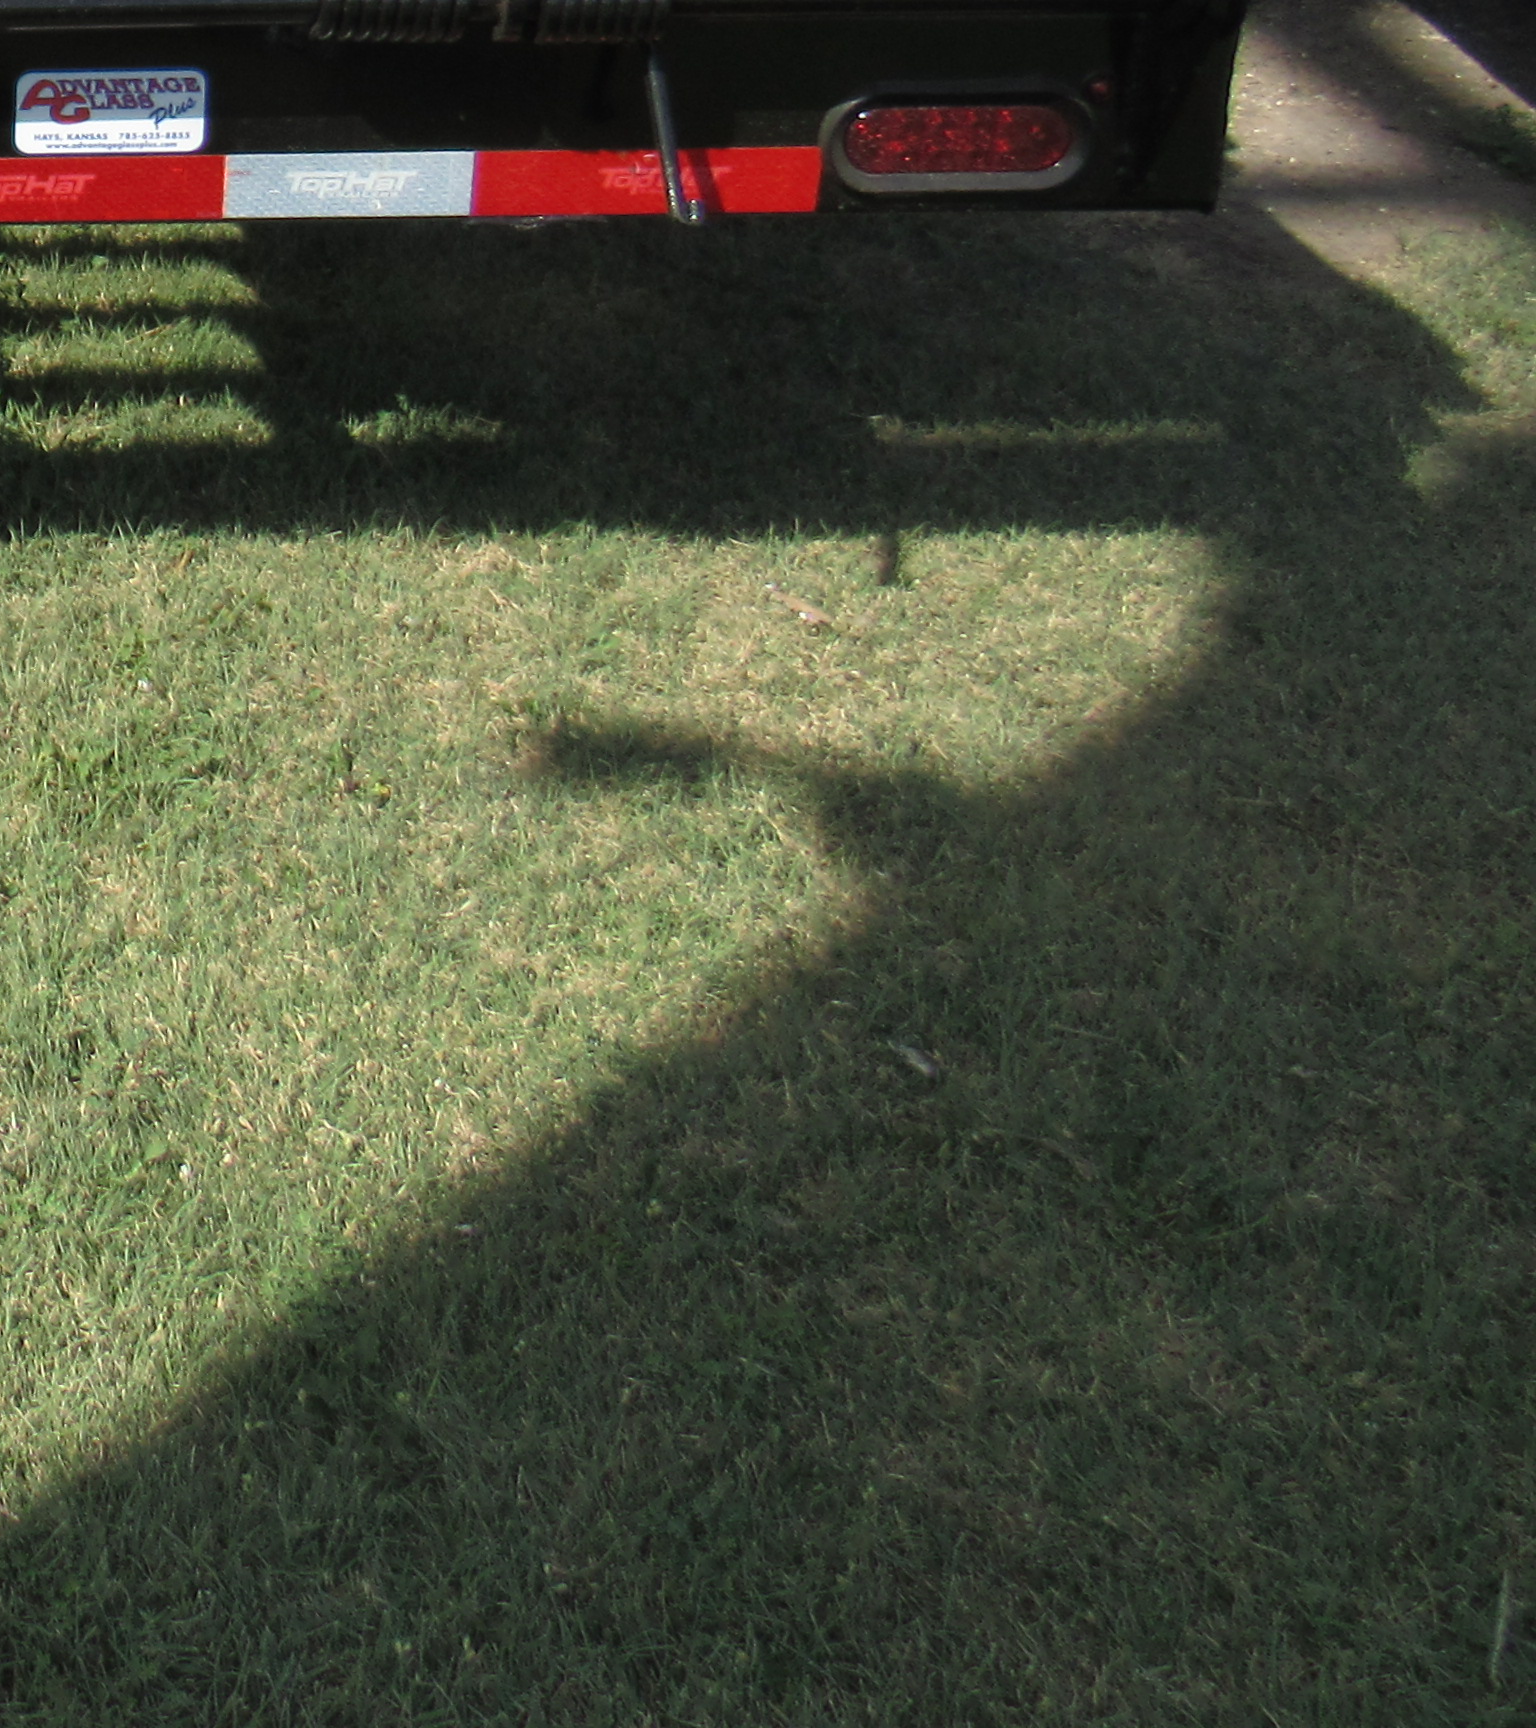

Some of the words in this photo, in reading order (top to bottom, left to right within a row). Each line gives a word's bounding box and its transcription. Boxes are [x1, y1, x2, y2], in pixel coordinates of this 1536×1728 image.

[20, 78, 201, 110] ADVANTAGE
[49, 94, 155, 124] GLASS
[149, 97, 197, 129] Plus
[67, 133, 108, 141] KANSAS
